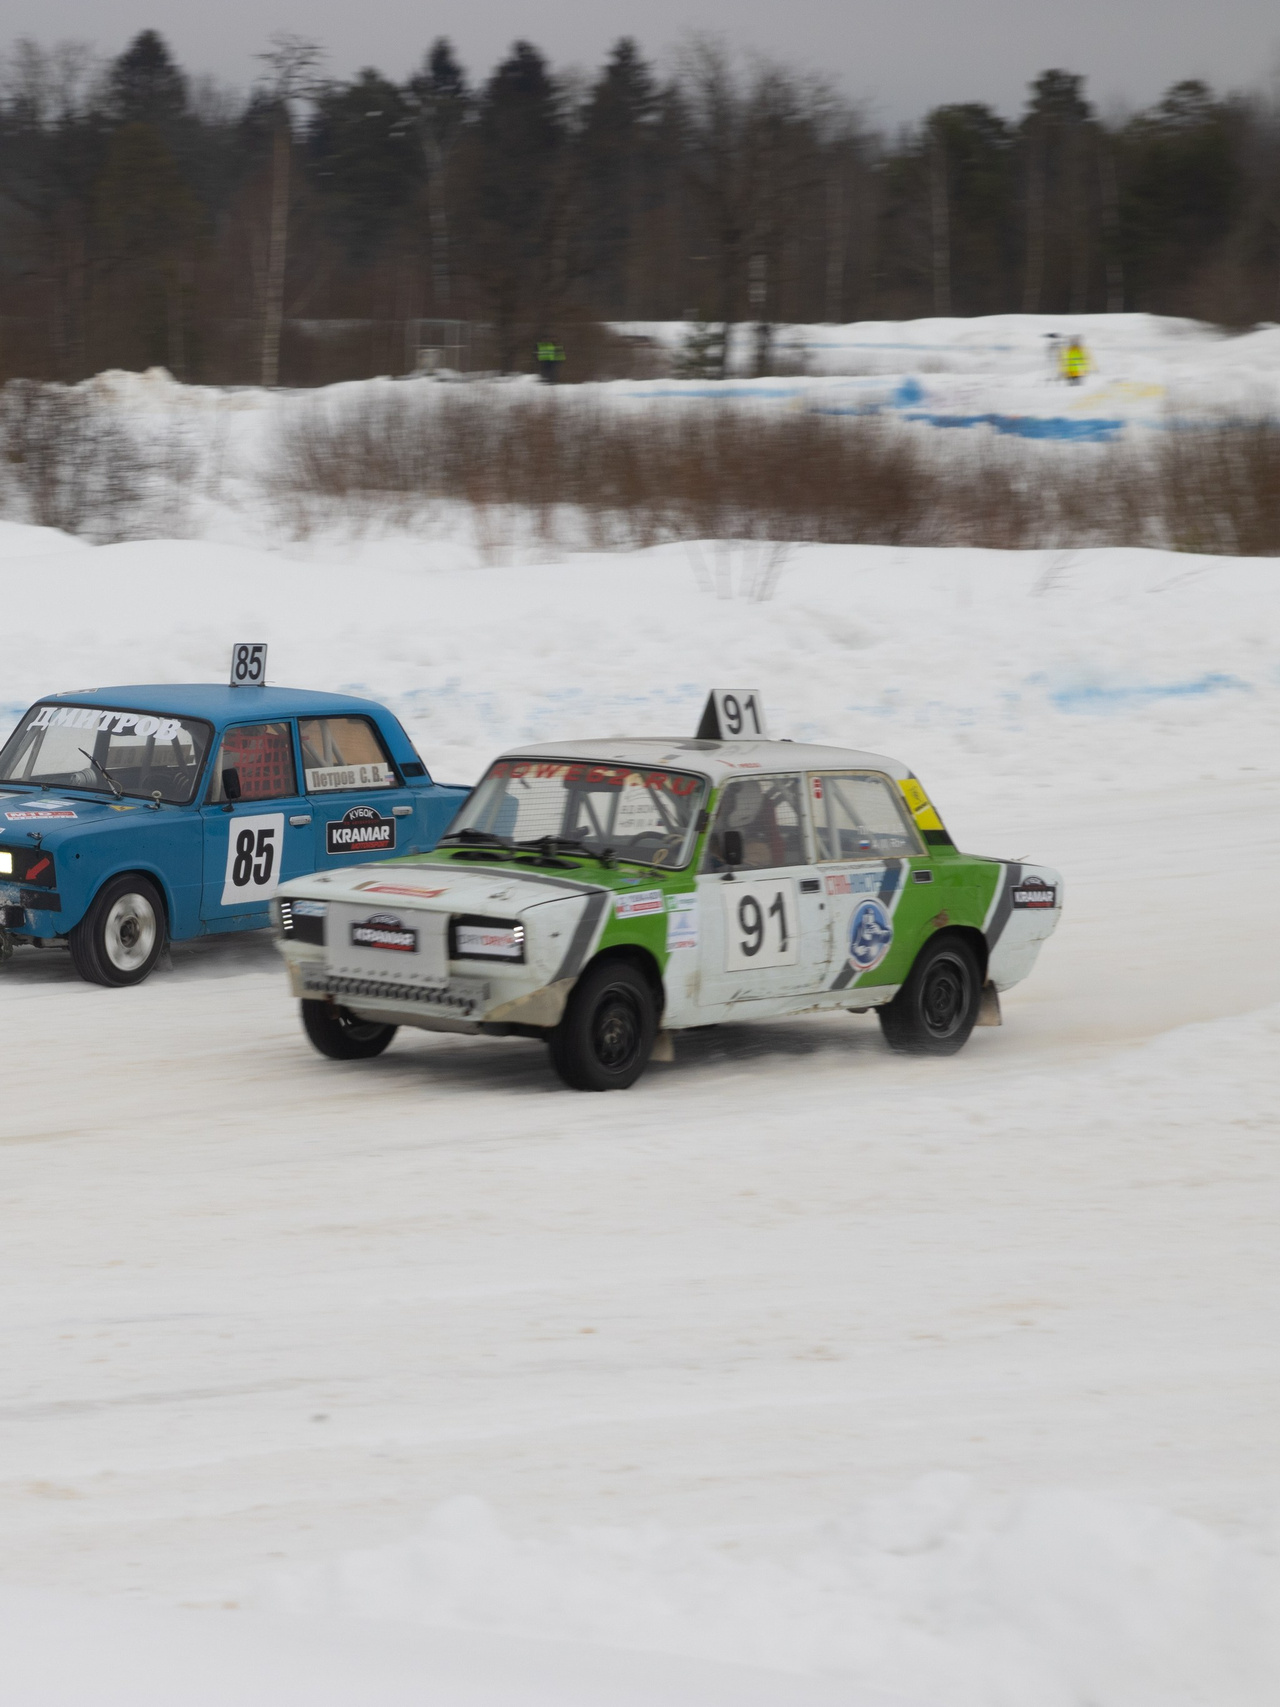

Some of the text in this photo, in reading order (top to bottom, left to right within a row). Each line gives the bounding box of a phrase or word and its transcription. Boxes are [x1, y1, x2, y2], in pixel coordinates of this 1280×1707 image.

[235, 645, 263, 680] 85
[26, 706, 181, 741] ДМИТРОВ
[723, 694, 762, 735] 91
[311, 770, 356, 788] Петров
[348, 808, 374, 820] КУБОК
[332, 825, 390, 844] KRAMAR
[232, 828, 275, 887] 85
[738, 891, 789, 957] 91
